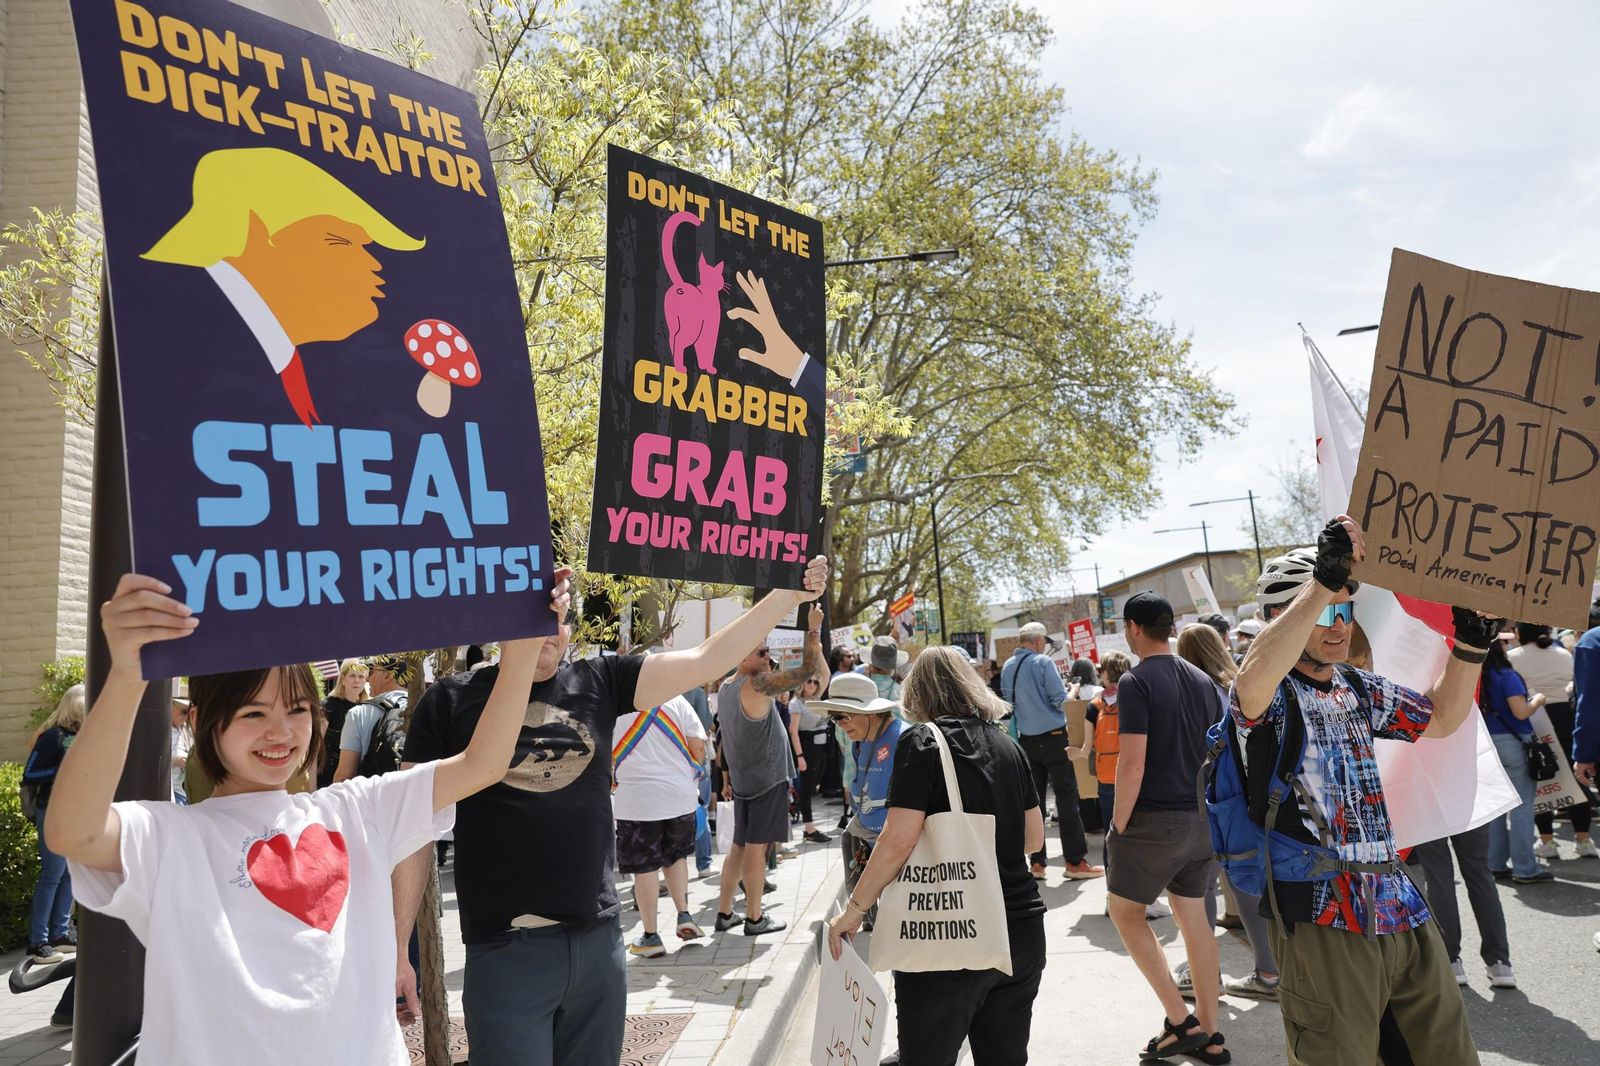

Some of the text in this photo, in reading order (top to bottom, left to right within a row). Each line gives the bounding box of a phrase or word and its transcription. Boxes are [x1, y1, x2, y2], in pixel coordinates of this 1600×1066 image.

[115, 0, 467, 150] DON'T LET THE
[628, 171, 811, 259] DON'T LET THE
[633, 359, 808, 436] GRABBER
[1374, 373, 1600, 486] A PAID
[192, 420, 509, 538] STEAL
[630, 432, 789, 521] GRAB
[606, 506, 809, 564] YOUR RIGHTS!
[1361, 468, 1597, 588] PROTESTER
[171, 545, 543, 614] YOUR RIGHTS!
[897, 861, 976, 884] ASECTOMIES
[908, 890, 964, 911] PREVENT
[900, 919, 977, 940] ABORTIONS
